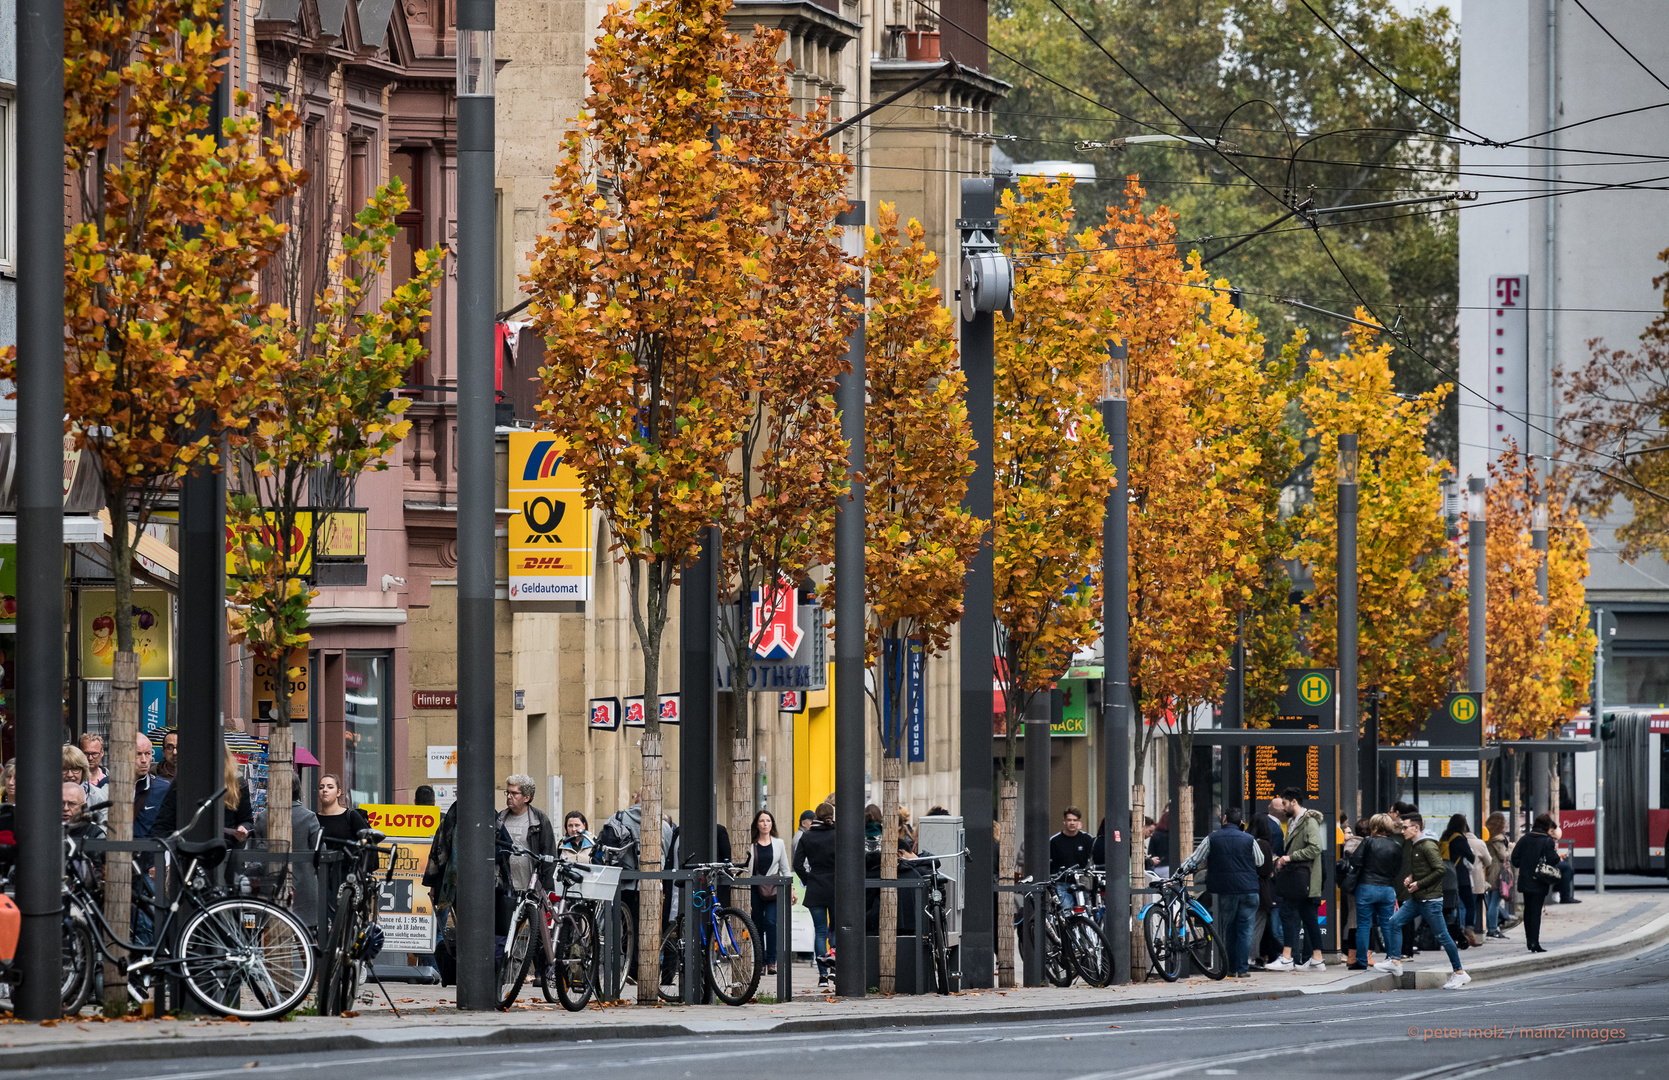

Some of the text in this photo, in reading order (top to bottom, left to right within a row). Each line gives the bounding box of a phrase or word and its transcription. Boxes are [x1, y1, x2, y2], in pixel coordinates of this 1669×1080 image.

[1497, 278, 1520, 306] T
[523, 557, 565, 569] DHL
[521, 582, 578, 593] Geldautomat
[255, 664, 307, 677] Coe
[289, 681, 307, 694] go
[1307, 680, 1322, 698] H
[417, 693, 451, 705] Hintere
[1457, 702, 1470, 717] H
[1050, 719, 1083, 731] NACK
[385, 814, 435, 828] LOTTO
[1563, 817, 1596, 829] Durchblick
[380, 915, 394, 923] hance
